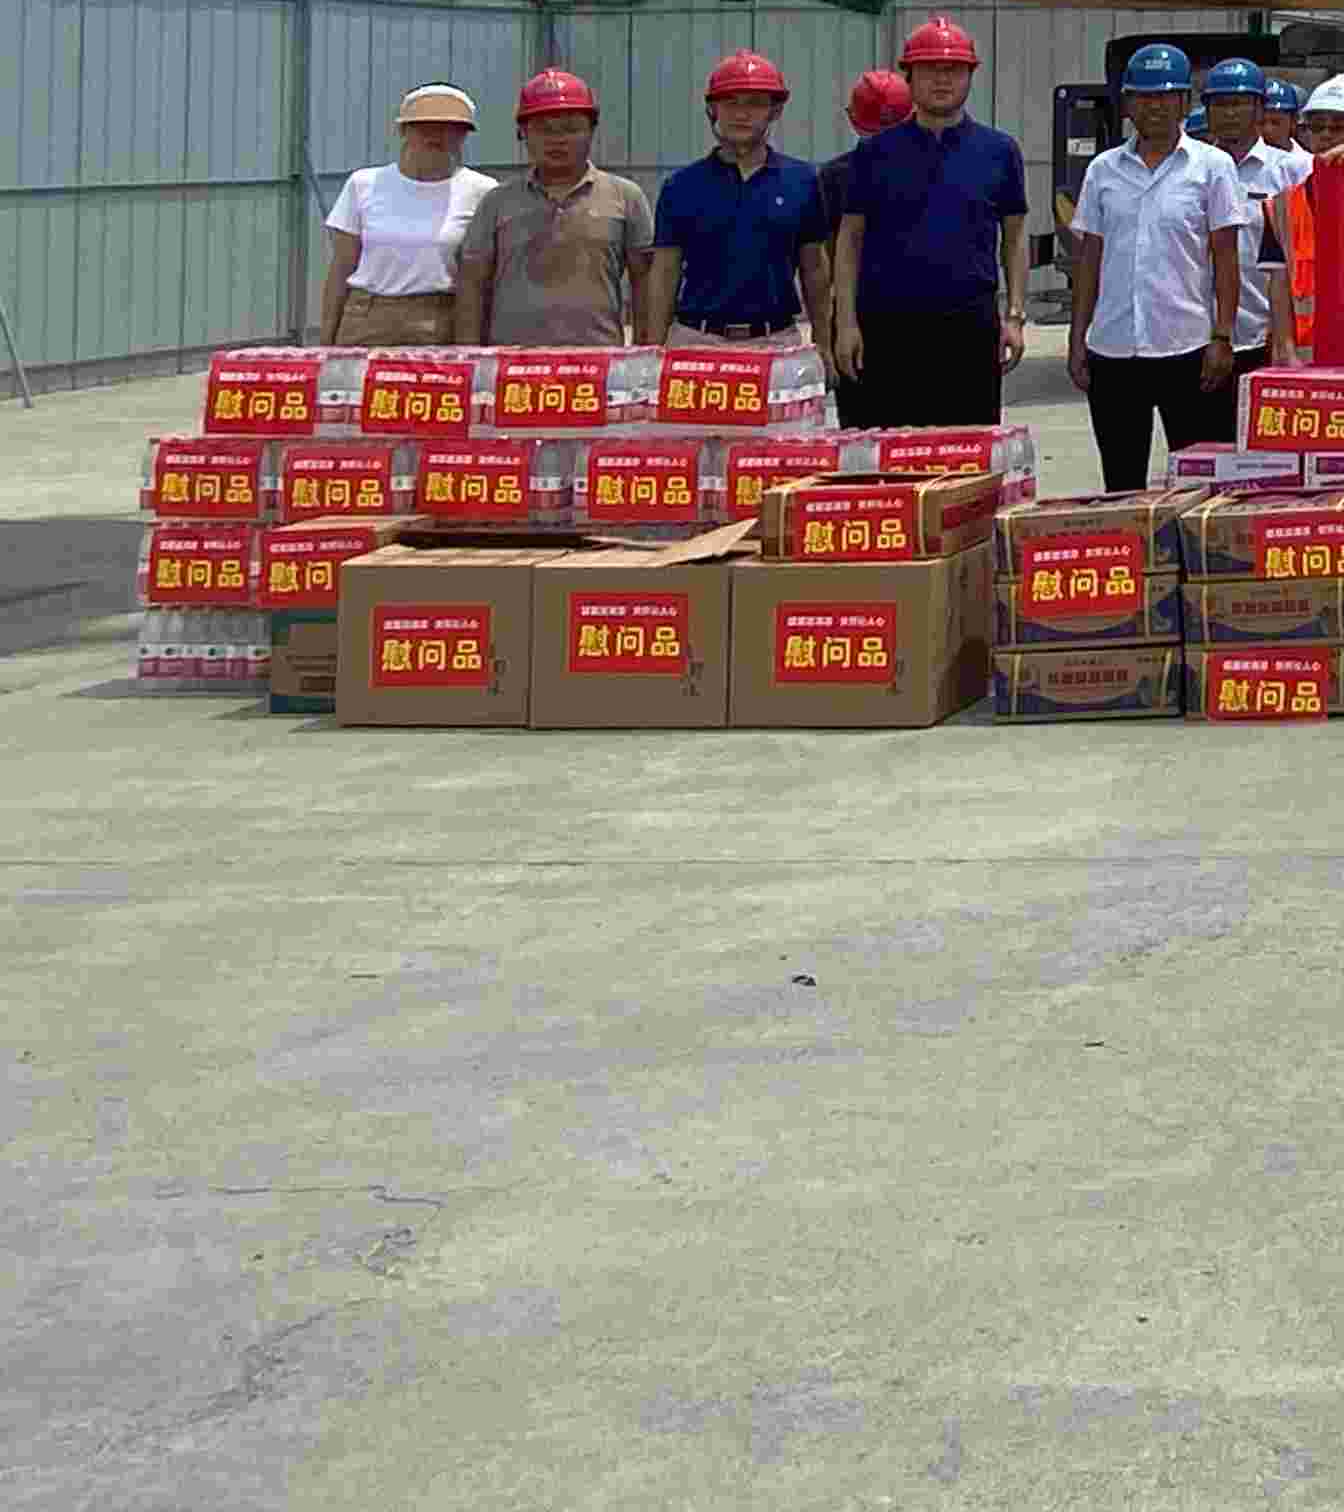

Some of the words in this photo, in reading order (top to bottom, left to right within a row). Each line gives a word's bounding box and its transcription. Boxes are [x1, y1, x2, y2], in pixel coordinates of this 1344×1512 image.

[214, 390, 307, 420] 慰问品
[369, 388, 464, 422] 慰问品
[503, 382, 599, 413] 慰问品
[667, 379, 761, 412] 慰问品
[160, 473, 252, 504] 慰问品
[292, 480, 384, 508] 慰问品
[425, 472, 522, 504] 慰问品
[596, 476, 691, 505] 慰问品
[804, 519, 906, 553] 慰问品
[157, 558, 244, 588] 慰问品
[269, 562, 335, 592] 慰问
[1033, 566, 1135, 601] 慰问品
[382, 640, 481, 671] 慰问品
[579, 625, 680, 657] 慰问品
[784, 635, 888, 668] 慰问品
[1219, 680, 1321, 713] 慰问品
